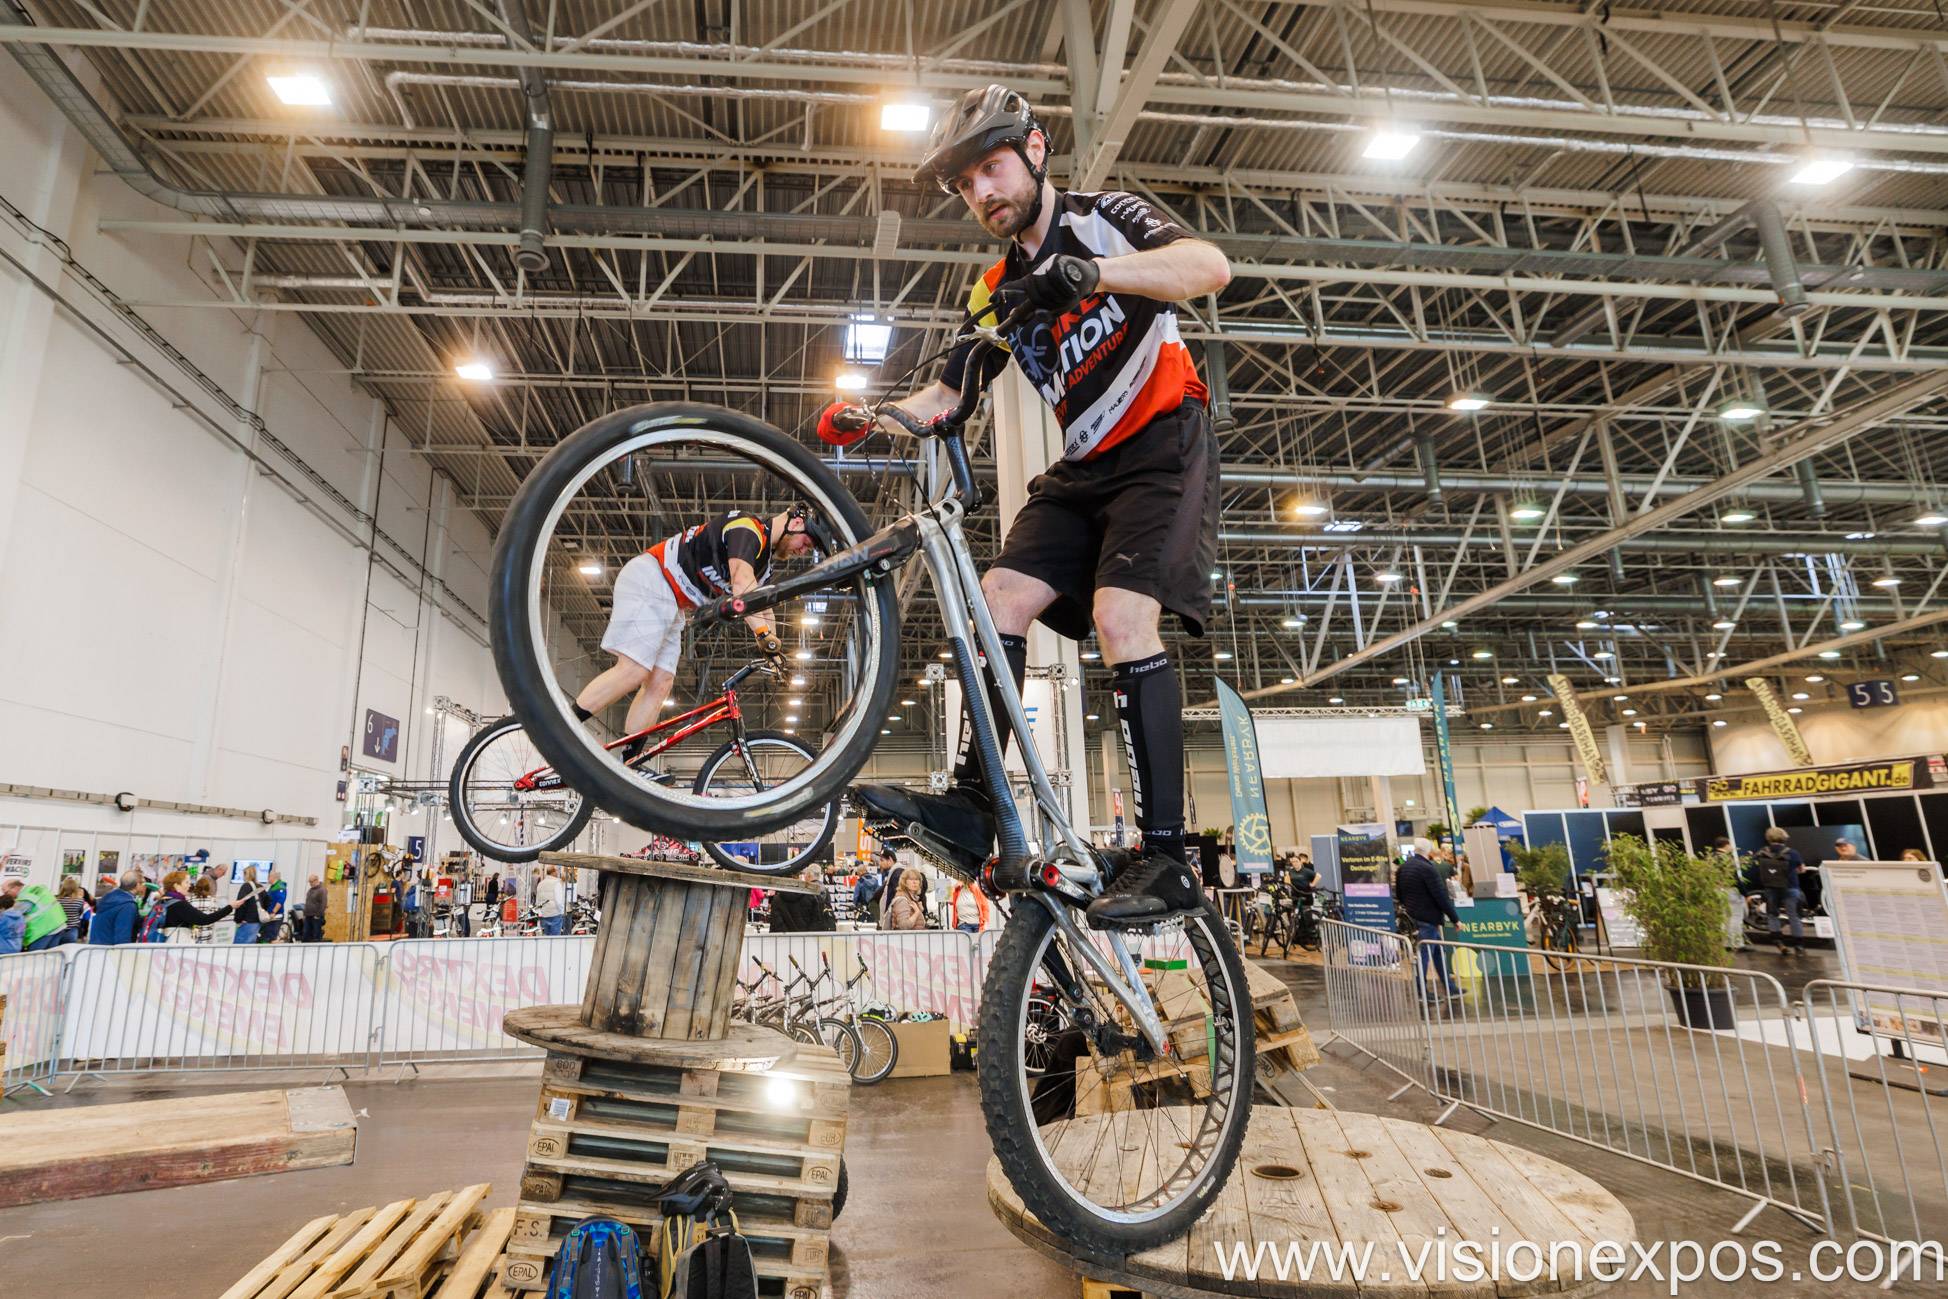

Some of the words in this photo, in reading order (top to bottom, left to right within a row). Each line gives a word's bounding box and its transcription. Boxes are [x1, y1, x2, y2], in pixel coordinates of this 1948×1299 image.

[1129, 658, 1168, 674] hebo
[1854, 684, 1871, 706] 5
[1879, 682, 1894, 704] 5
[367, 714, 374, 734] 6
[1743, 768, 1910, 797] FAHRRADGIGANT.de
[415, 840, 422, 860] 5
[1463, 921, 1520, 933] NEARBYK
[537, 1141, 555, 1153] EPAL
[811, 1169, 829, 1181] EPAL
[512, 1267, 535, 1278] EPAL
